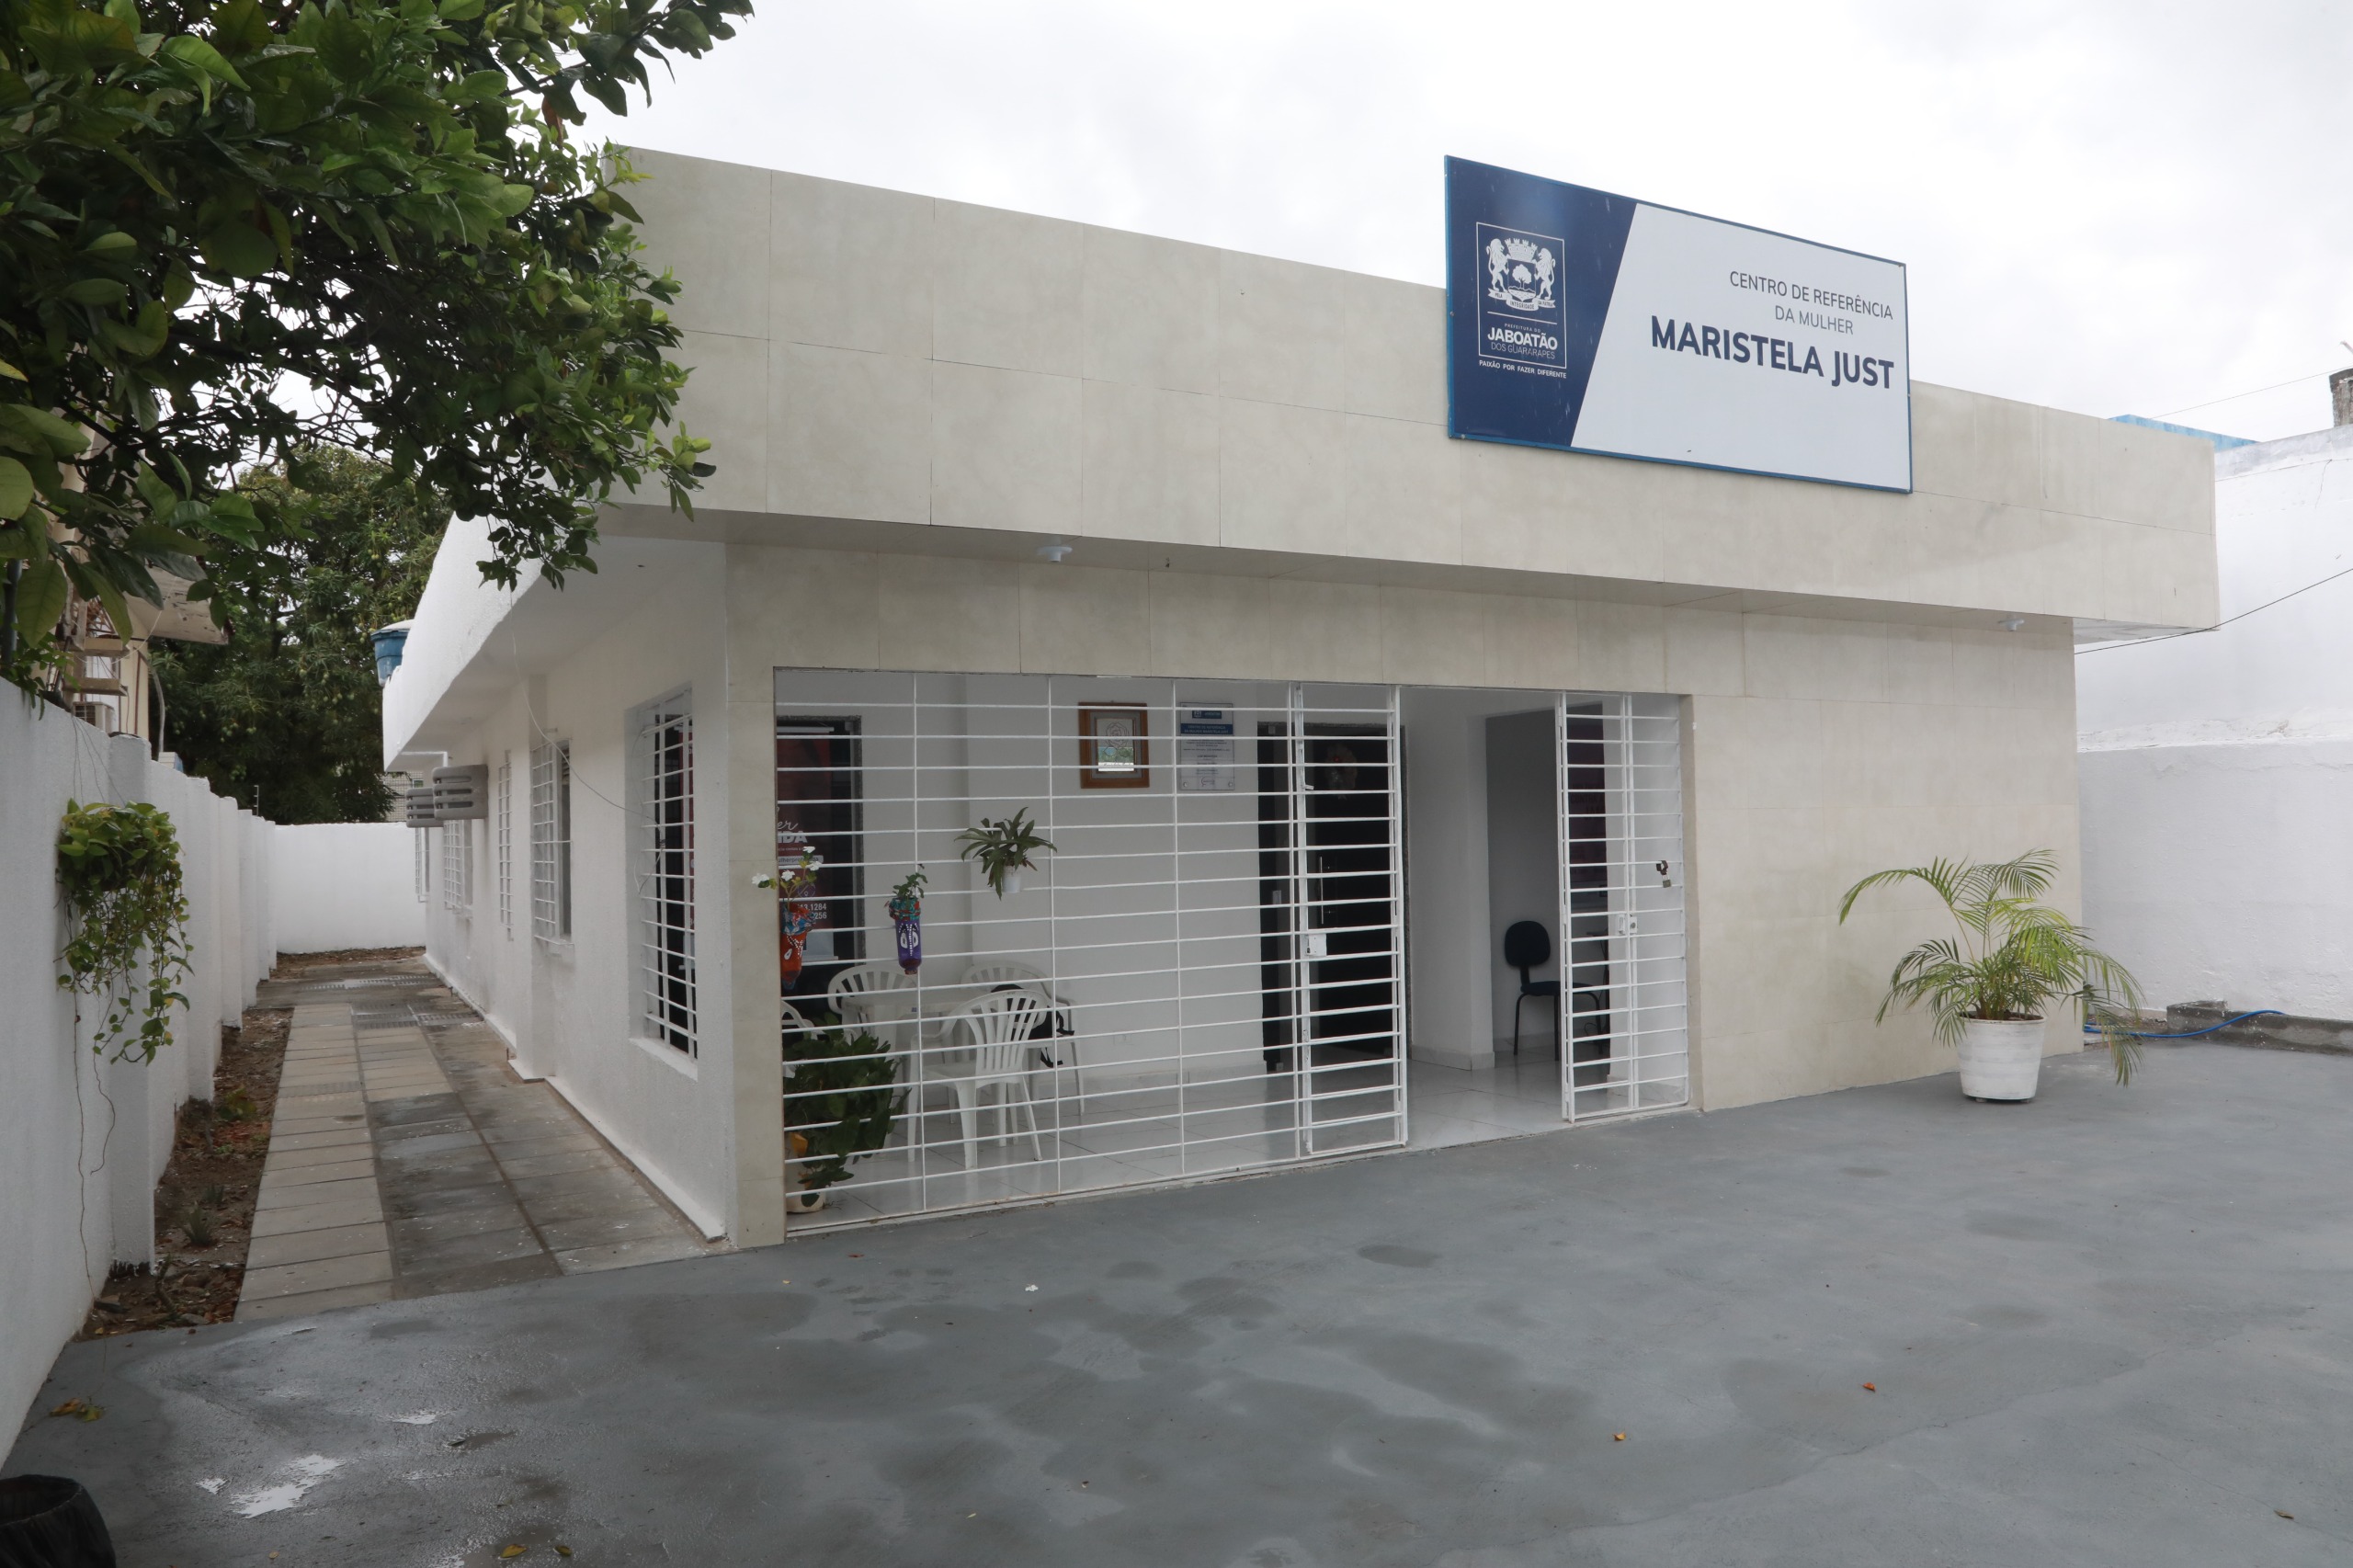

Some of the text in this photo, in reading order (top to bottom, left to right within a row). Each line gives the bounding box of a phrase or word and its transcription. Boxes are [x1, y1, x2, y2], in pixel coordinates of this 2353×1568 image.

[1509, 301, 1535, 310] INTEGRIDADE
[1730, 270, 1893, 320] CENTRO DE REFERÊNCIA
[1504, 323, 1532, 332] PREFEITURA
[1775, 305, 1854, 335] DA MULHER
[1487, 327, 1558, 350] JABOATÃO
[1491, 342, 1556, 359] DOS GUARARAPES
[1651, 315, 1895, 390] MARISTELA JUST
[1479, 359, 1567, 379] PAIXÃO POR FAZER DIFERENTE
